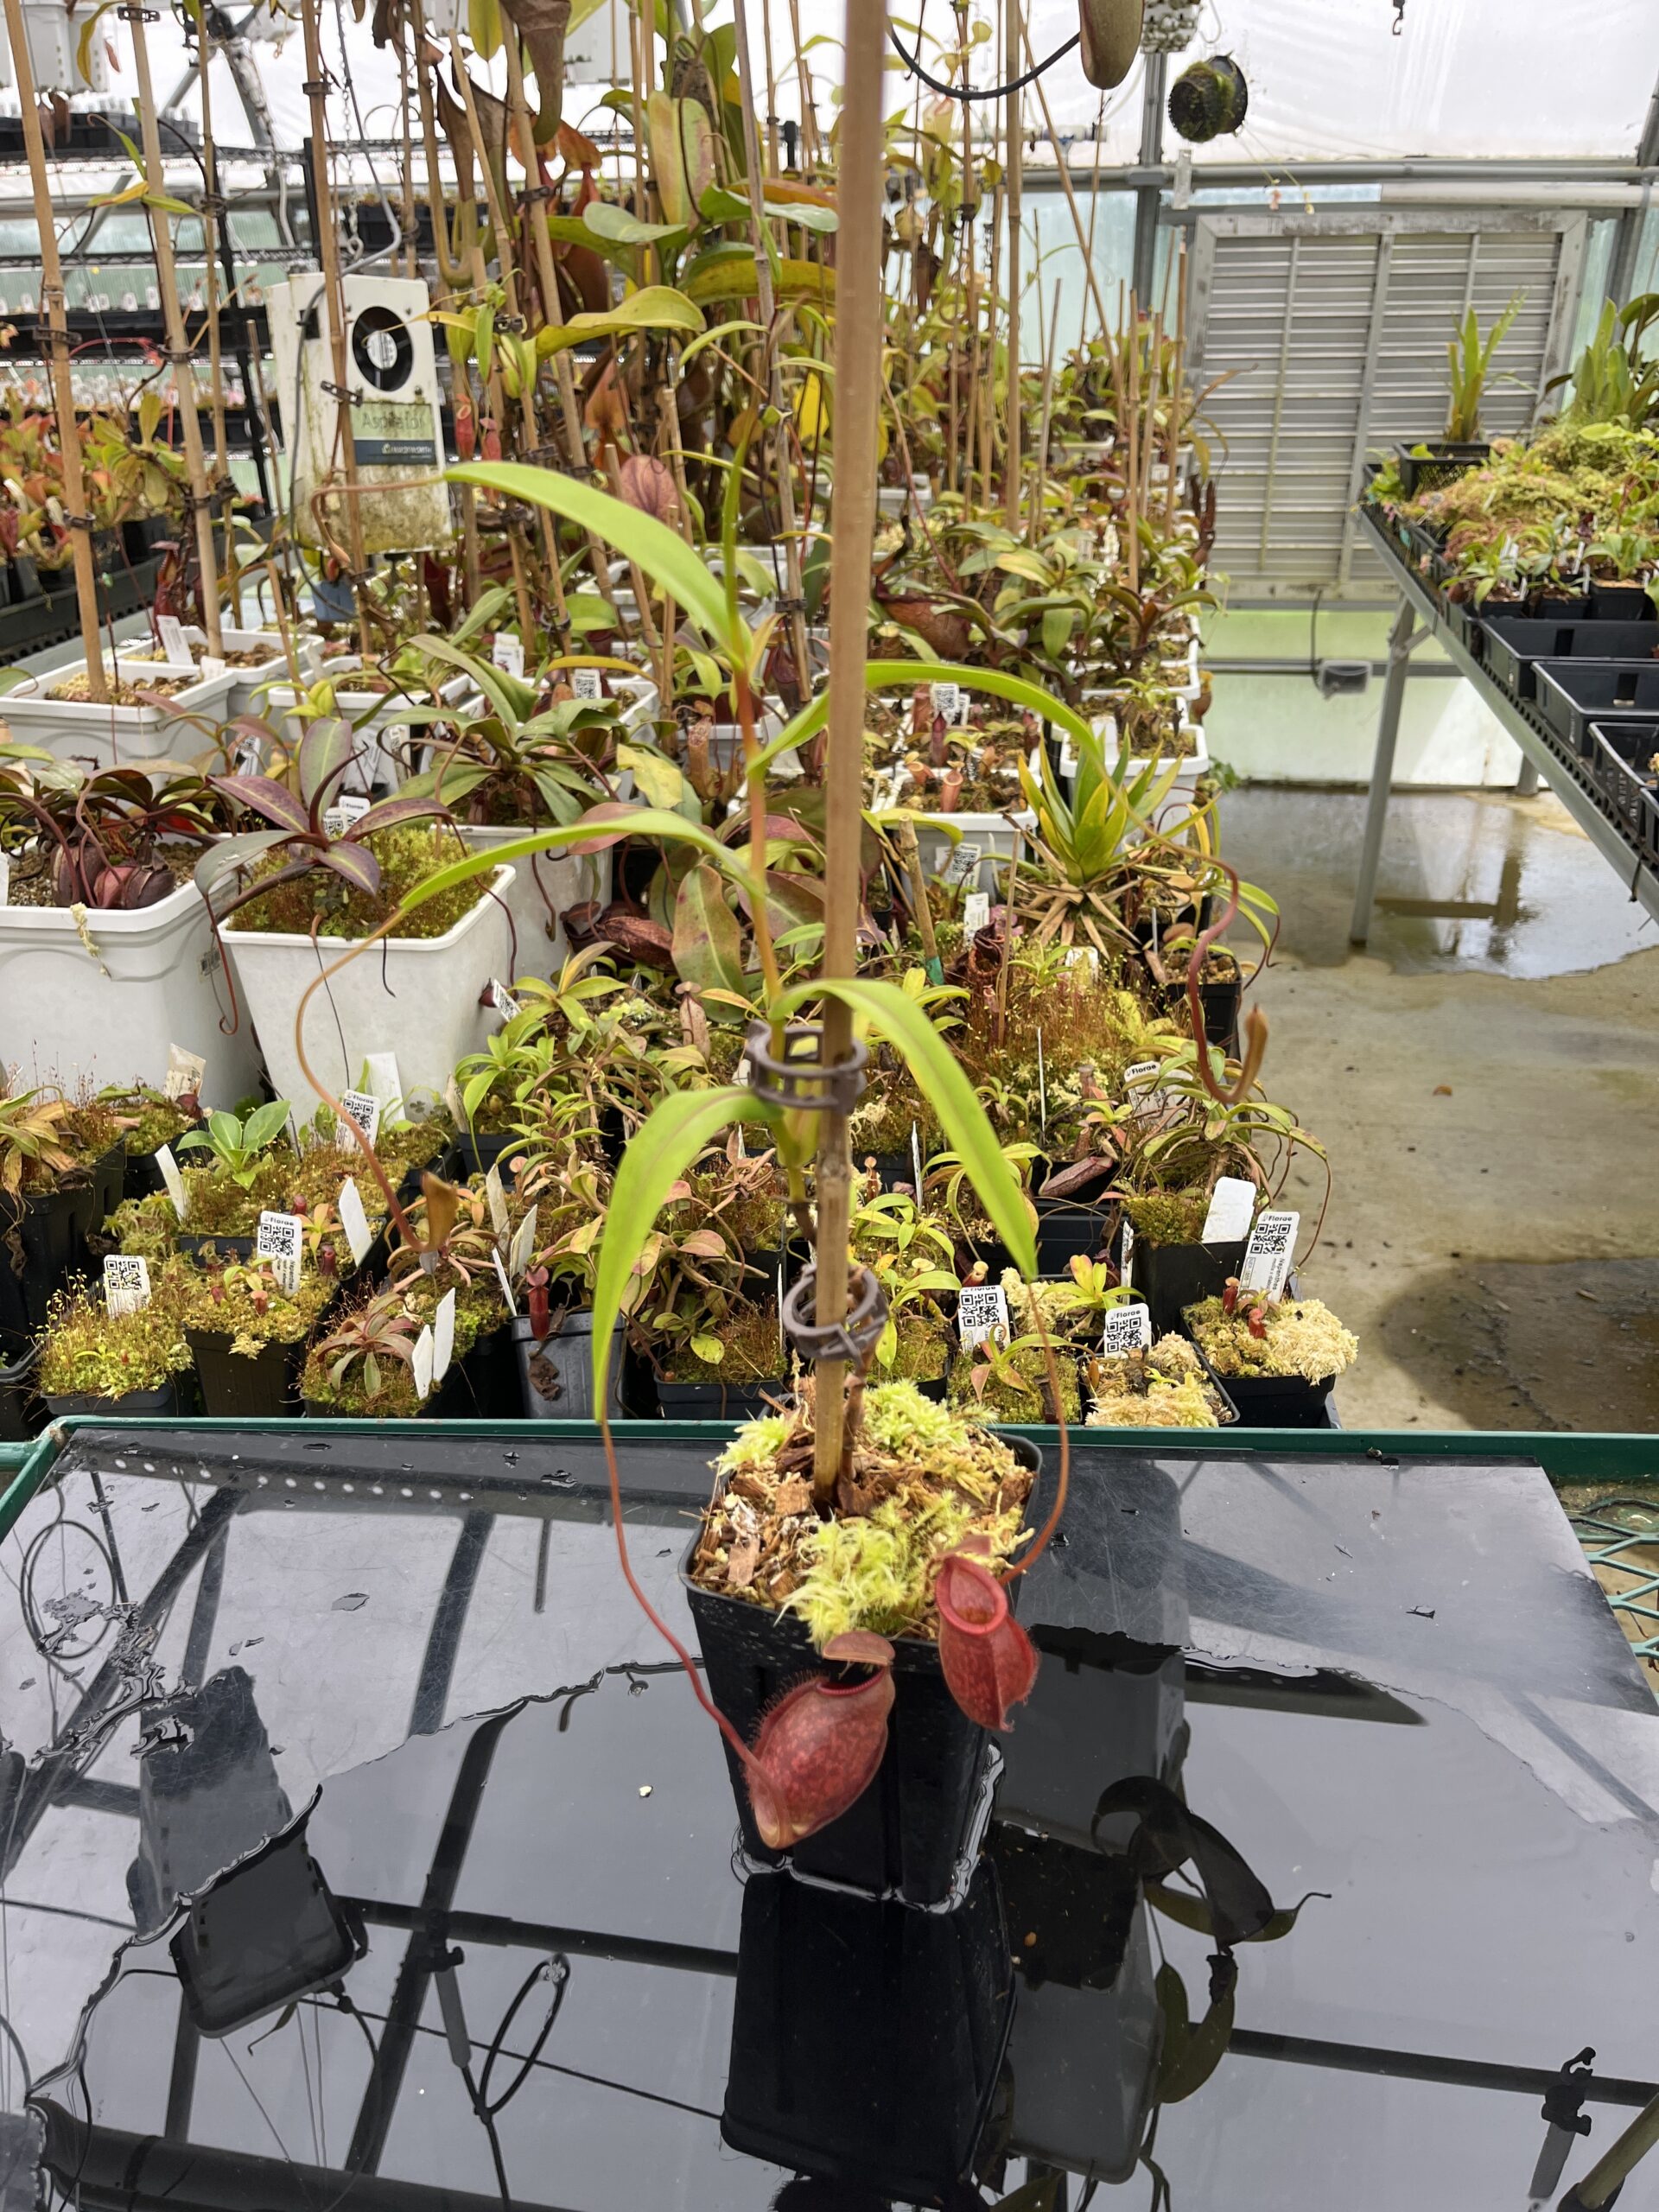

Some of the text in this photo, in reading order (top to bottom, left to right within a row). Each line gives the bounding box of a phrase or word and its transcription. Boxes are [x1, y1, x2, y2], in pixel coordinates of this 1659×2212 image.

[1131, 1064, 1156, 1074] Florae
[353, 1094, 374, 1104] Florae
[270, 1217, 294, 1226] Florae
[1273, 1257, 1286, 1290] Nepenthes
[1116, 1310, 1141, 1319] Florae
